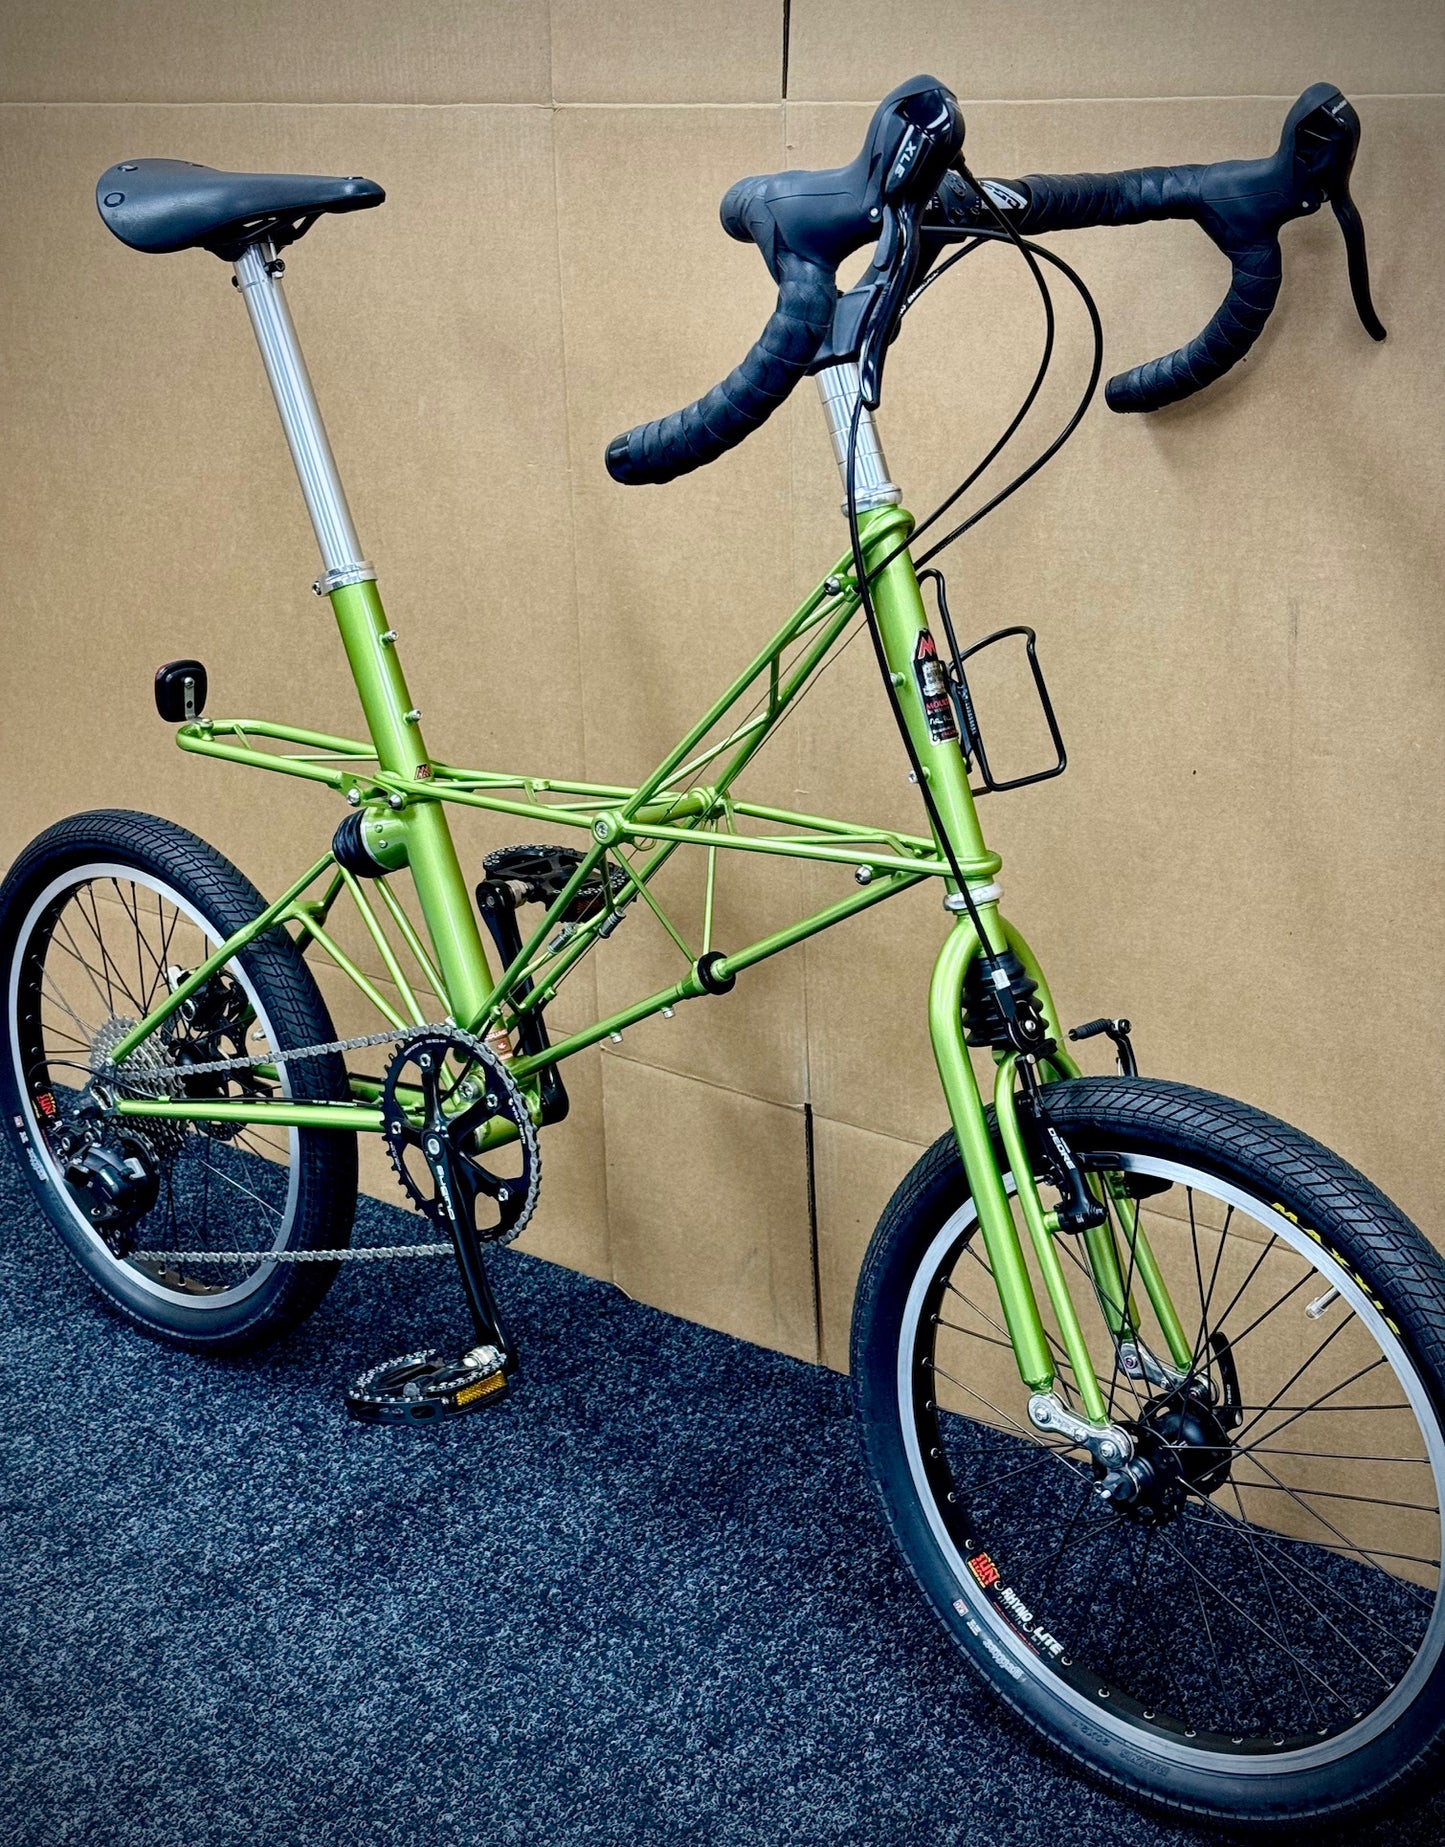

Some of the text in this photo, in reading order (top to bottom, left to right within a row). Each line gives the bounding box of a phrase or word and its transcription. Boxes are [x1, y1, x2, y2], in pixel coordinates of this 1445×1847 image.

[895, 140, 917, 178] XLE
[1047, 1127, 1077, 1170] DEORE
[974, 1553, 999, 1583] SUN
[1001, 1586, 1034, 1624] RHYNO
[1033, 1625, 1064, 1656] LITE
